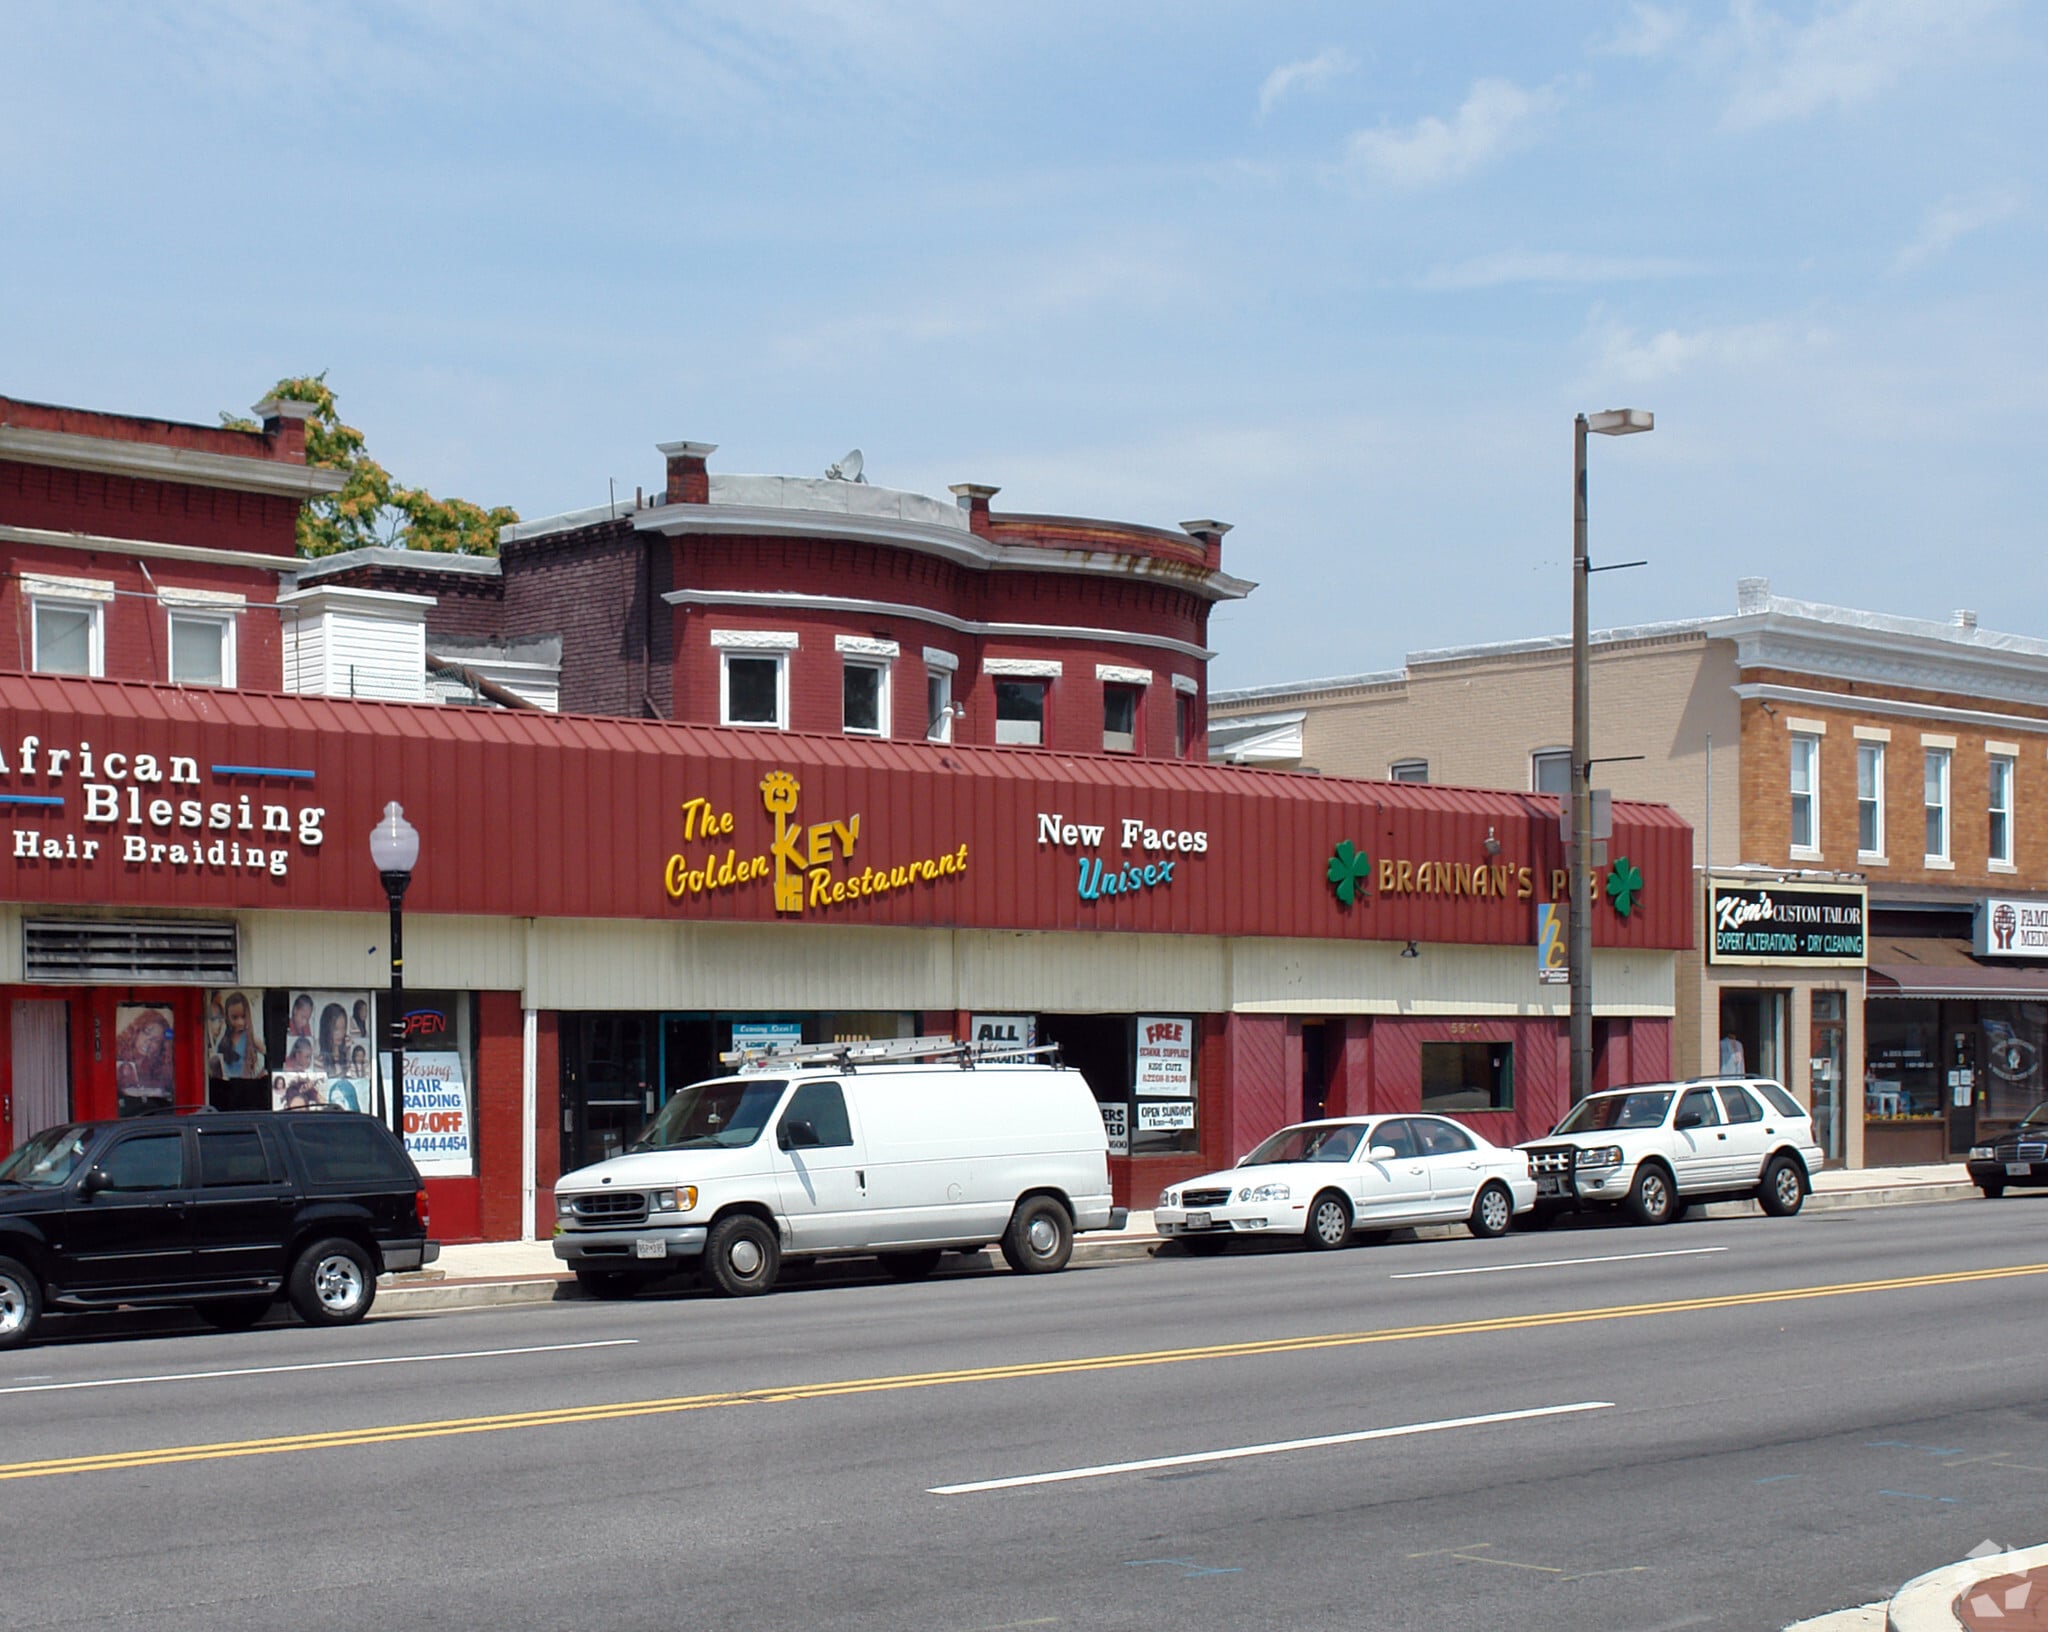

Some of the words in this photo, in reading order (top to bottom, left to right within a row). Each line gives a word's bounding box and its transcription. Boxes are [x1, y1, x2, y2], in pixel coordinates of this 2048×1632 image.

[83, 783, 326, 845] Blessing
[682, 797, 734, 841] The
[1037, 813, 1105, 847] New
[1121, 818, 1208, 852] Faces
[13, 830, 99, 860] Hair
[123, 835, 289, 876] Braiding
[665, 849, 769, 898] Golden
[809, 843, 968, 908] Restaurant
[1078, 857, 1175, 900] Unisex
[1378, 859, 1534, 899] BRANNAN'S
[1552, 869, 1599, 901] PB
[1715, 891, 1773, 931] Kim's
[1773, 905, 1821, 923] CUSTOM
[1823, 906, 1861, 925] TAILOR
[1717, 932, 1745, 950] EXPERT
[1745, 932, 1797, 951] ALTERATIONS
[1808, 934, 1823, 952] DRY
[1823, 935, 1862, 953] CLEANING
[977, 1024, 1019, 1041] ALL
[1145, 1022, 1184, 1045] FREE
[403, 1094, 461, 1109] RAIDING
[405, 1079, 443, 1094] HAIR
[1102, 1109, 1124, 1122] ERS
[1141, 1106, 1160, 1118] OPEN
[1161, 1105, 1192, 1117] SUNDAYS
[403, 1136, 467, 1152] 0-444-4454
